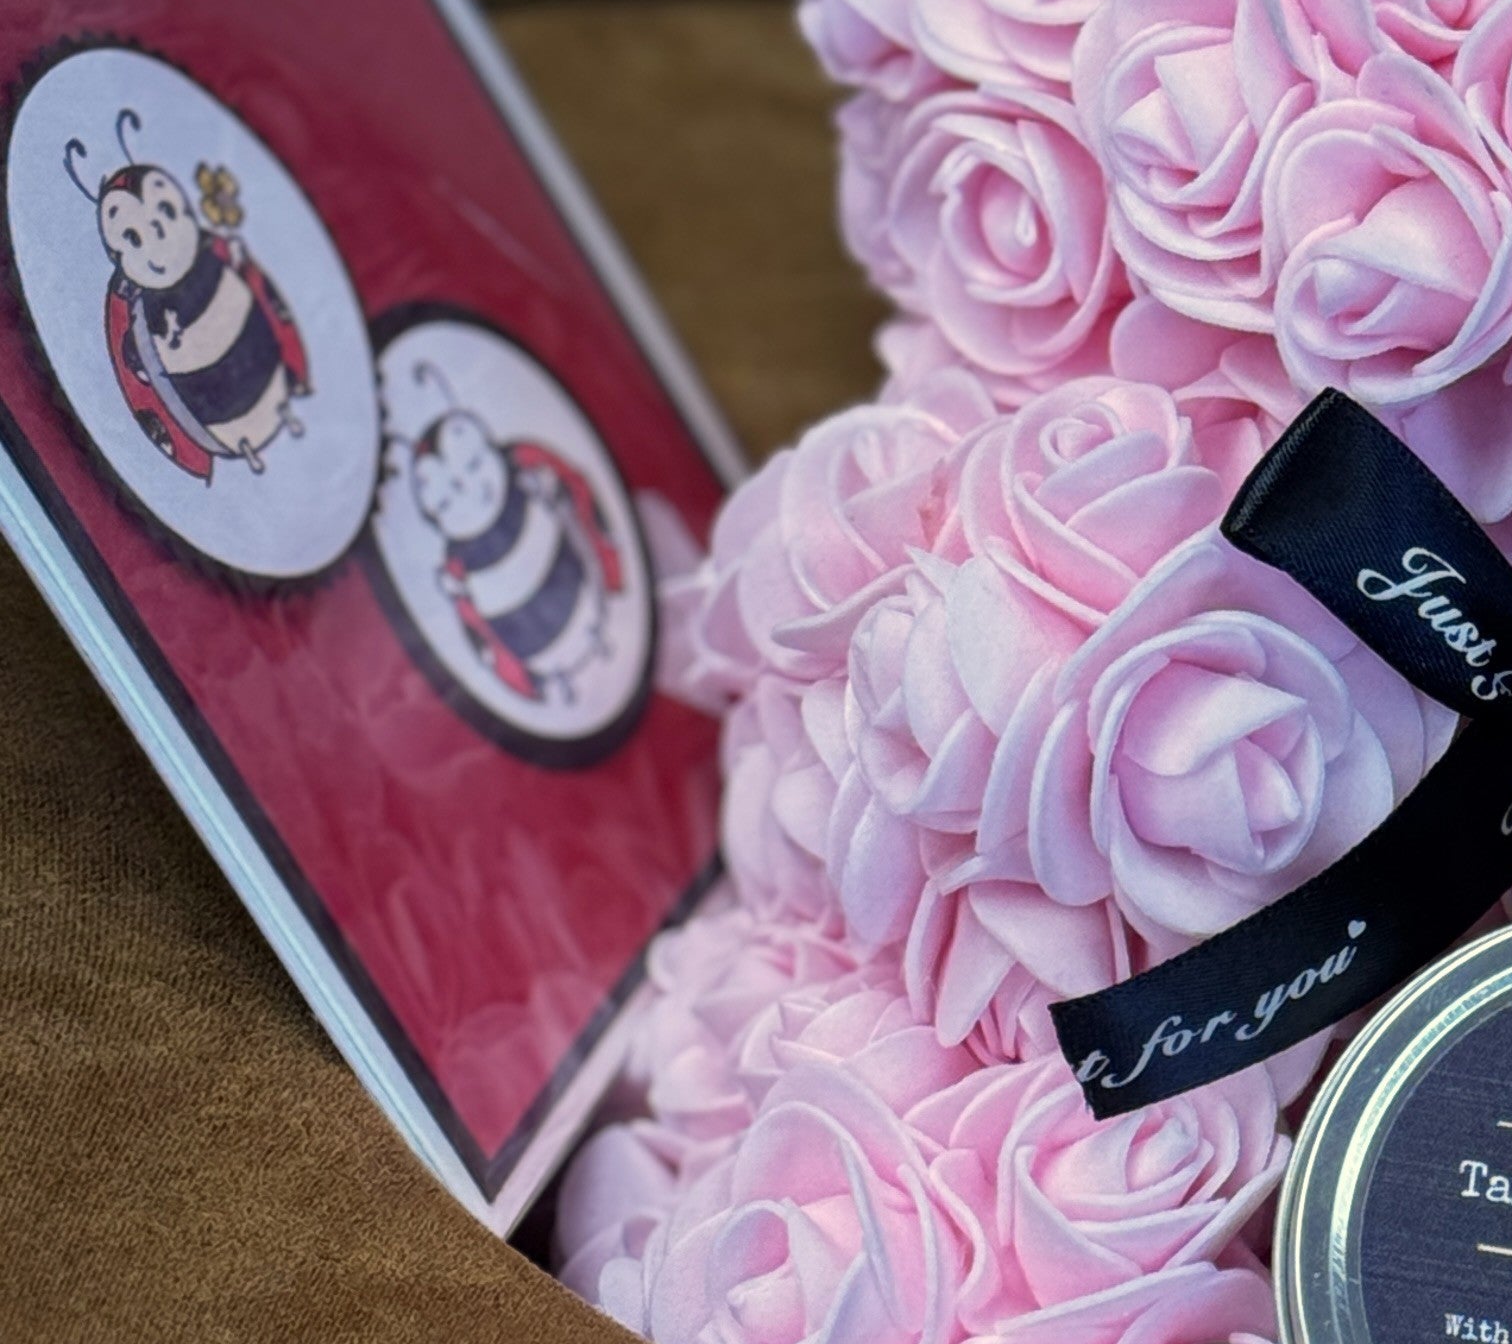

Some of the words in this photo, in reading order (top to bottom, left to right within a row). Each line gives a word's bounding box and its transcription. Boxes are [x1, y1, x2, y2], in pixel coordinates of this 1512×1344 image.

[1357, 547, 1497, 667] Just
[1100, 1015, 1237, 1089] for
[1234, 945, 1358, 1041] you
